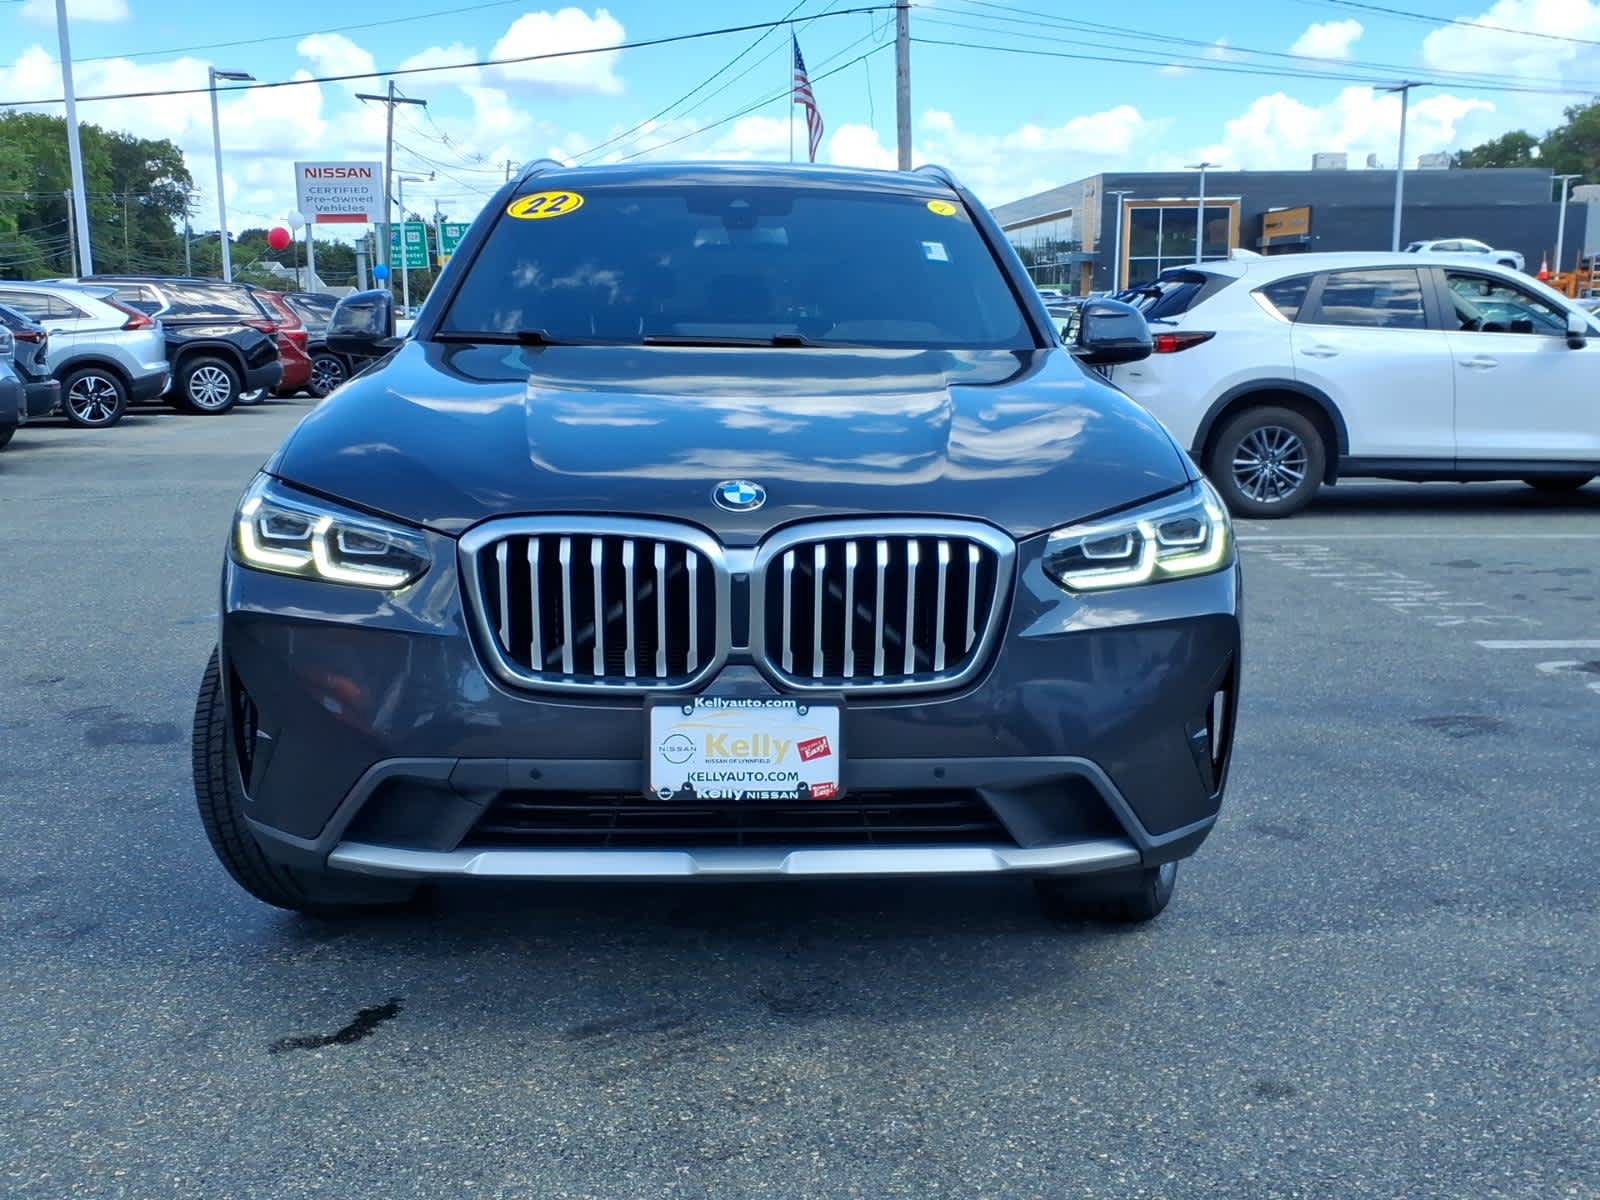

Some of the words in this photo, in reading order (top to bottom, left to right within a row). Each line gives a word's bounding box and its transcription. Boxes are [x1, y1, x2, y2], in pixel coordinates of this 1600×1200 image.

[304, 167, 372, 179] NISSAN
[308, 186, 369, 194] CERTIFIED
[305, 195, 374, 204] Pre-Owned
[521, 194, 569, 215] 22
[315, 204, 366, 212] Vehicles
[694, 697, 796, 709] Kellyauto.com
[705, 733, 792, 764] Kelly
[687, 771, 799, 782] KELLYAUTO.COM
[696, 788, 745, 800] Kelly
[746, 791, 799, 799] NISSAN
